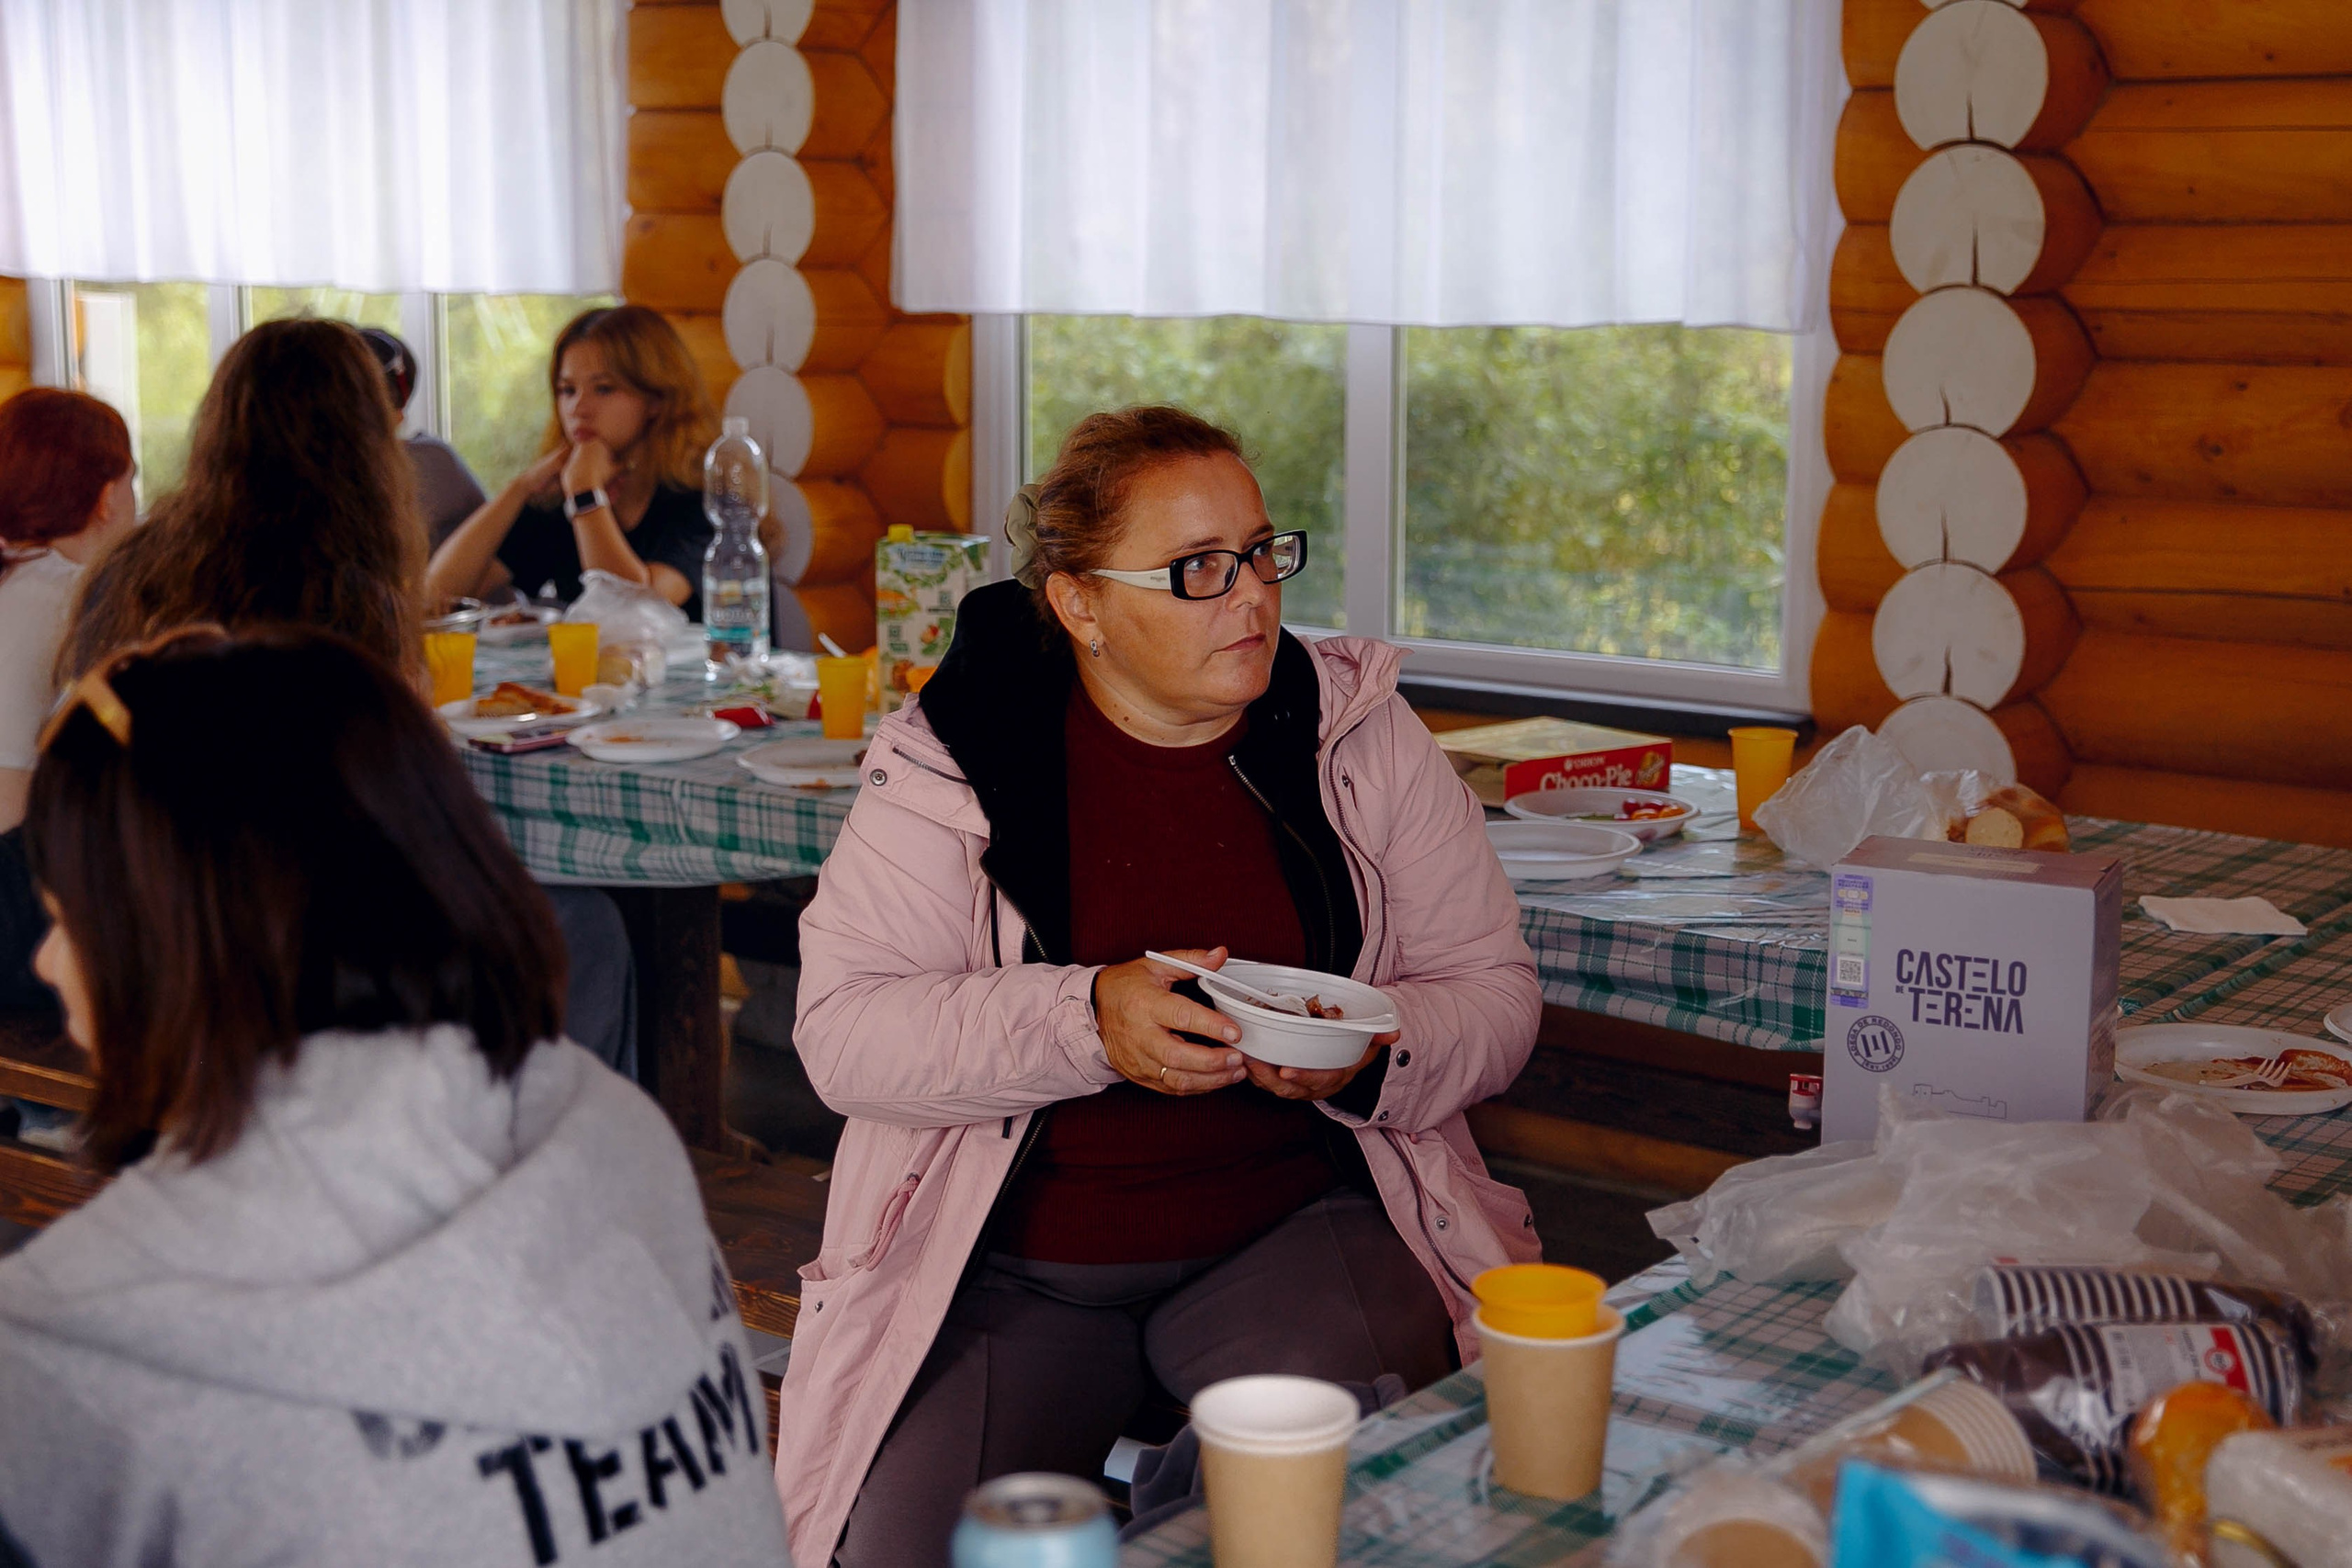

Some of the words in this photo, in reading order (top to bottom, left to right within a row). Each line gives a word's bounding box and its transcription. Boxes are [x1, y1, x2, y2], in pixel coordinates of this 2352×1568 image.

[1895, 986, 1904, 994] DE
[1896, 949, 2027, 997] CASTELO
[1908, 987, 2024, 1034] TERENA
[1871, 1018, 1902, 1051] REDONDO
[476, 1341, 759, 1567] TEAM
